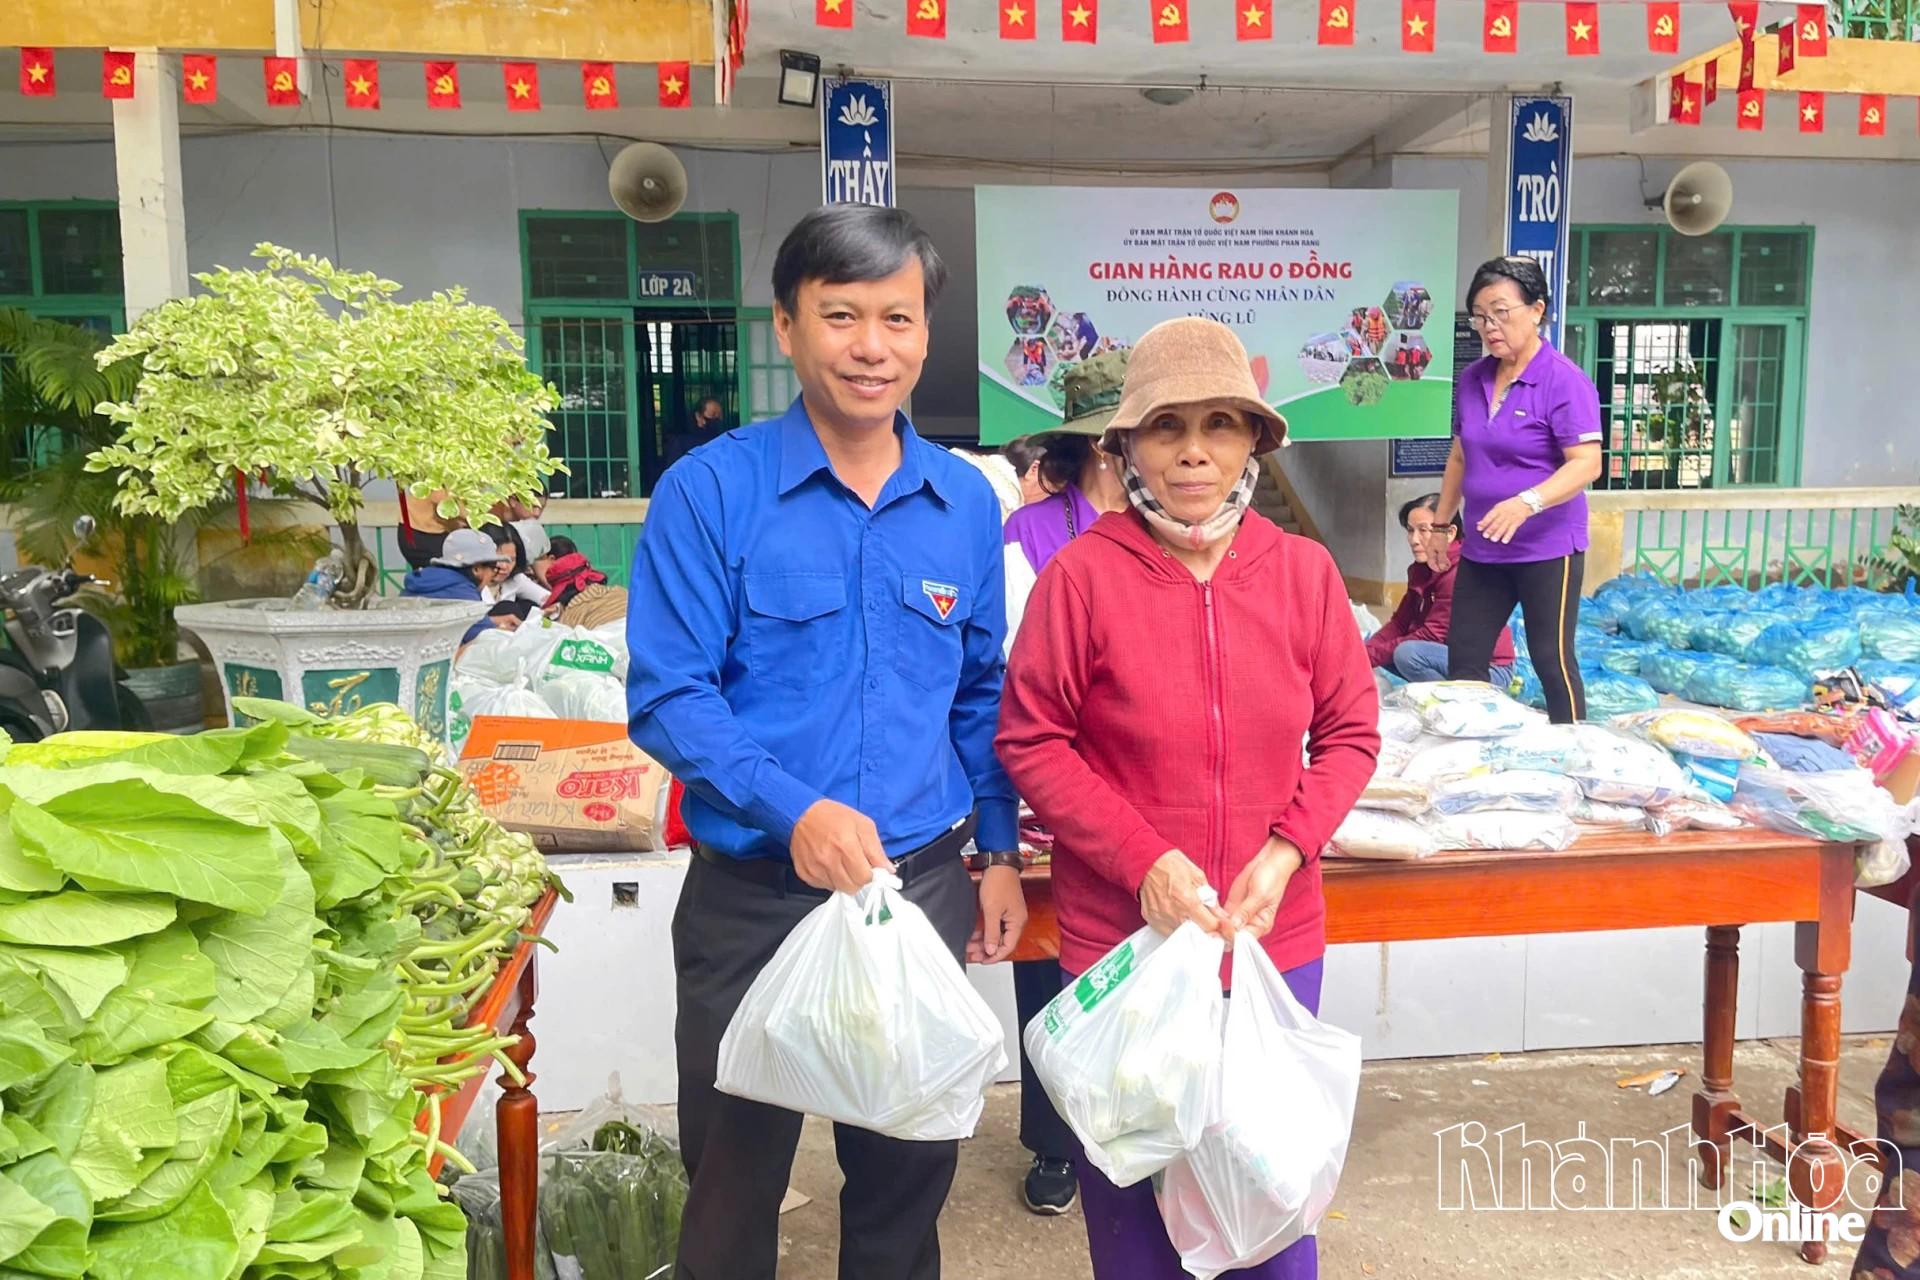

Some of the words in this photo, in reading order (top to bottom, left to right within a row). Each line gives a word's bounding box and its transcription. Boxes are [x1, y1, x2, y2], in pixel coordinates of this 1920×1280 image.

[830, 130, 888, 206] THẦY
[1517, 161, 1560, 222] TRÒ
[1141, 228, 1155, 236] BAN
[1240, 228, 1256, 236] NAM
[1233, 239, 1250, 247] NAM
[1089, 262, 1144, 280] GIAN
[1149, 254, 1213, 280] HÀNG
[1218, 262, 1264, 279] RAU
[1288, 249, 1352, 279] ĐỒNG
[641, 273, 669, 296] LỚP
[673, 277, 692, 296] 2A
[1158, 286, 1202, 302] HÀNH
[1207, 286, 1251, 302] CÙNG
[1256, 285, 1299, 301] NHÂN
[1304, 285, 1335, 301] DÂN
[1237, 309, 1256, 324] LŨ
[556, 774, 640, 802] Karo
